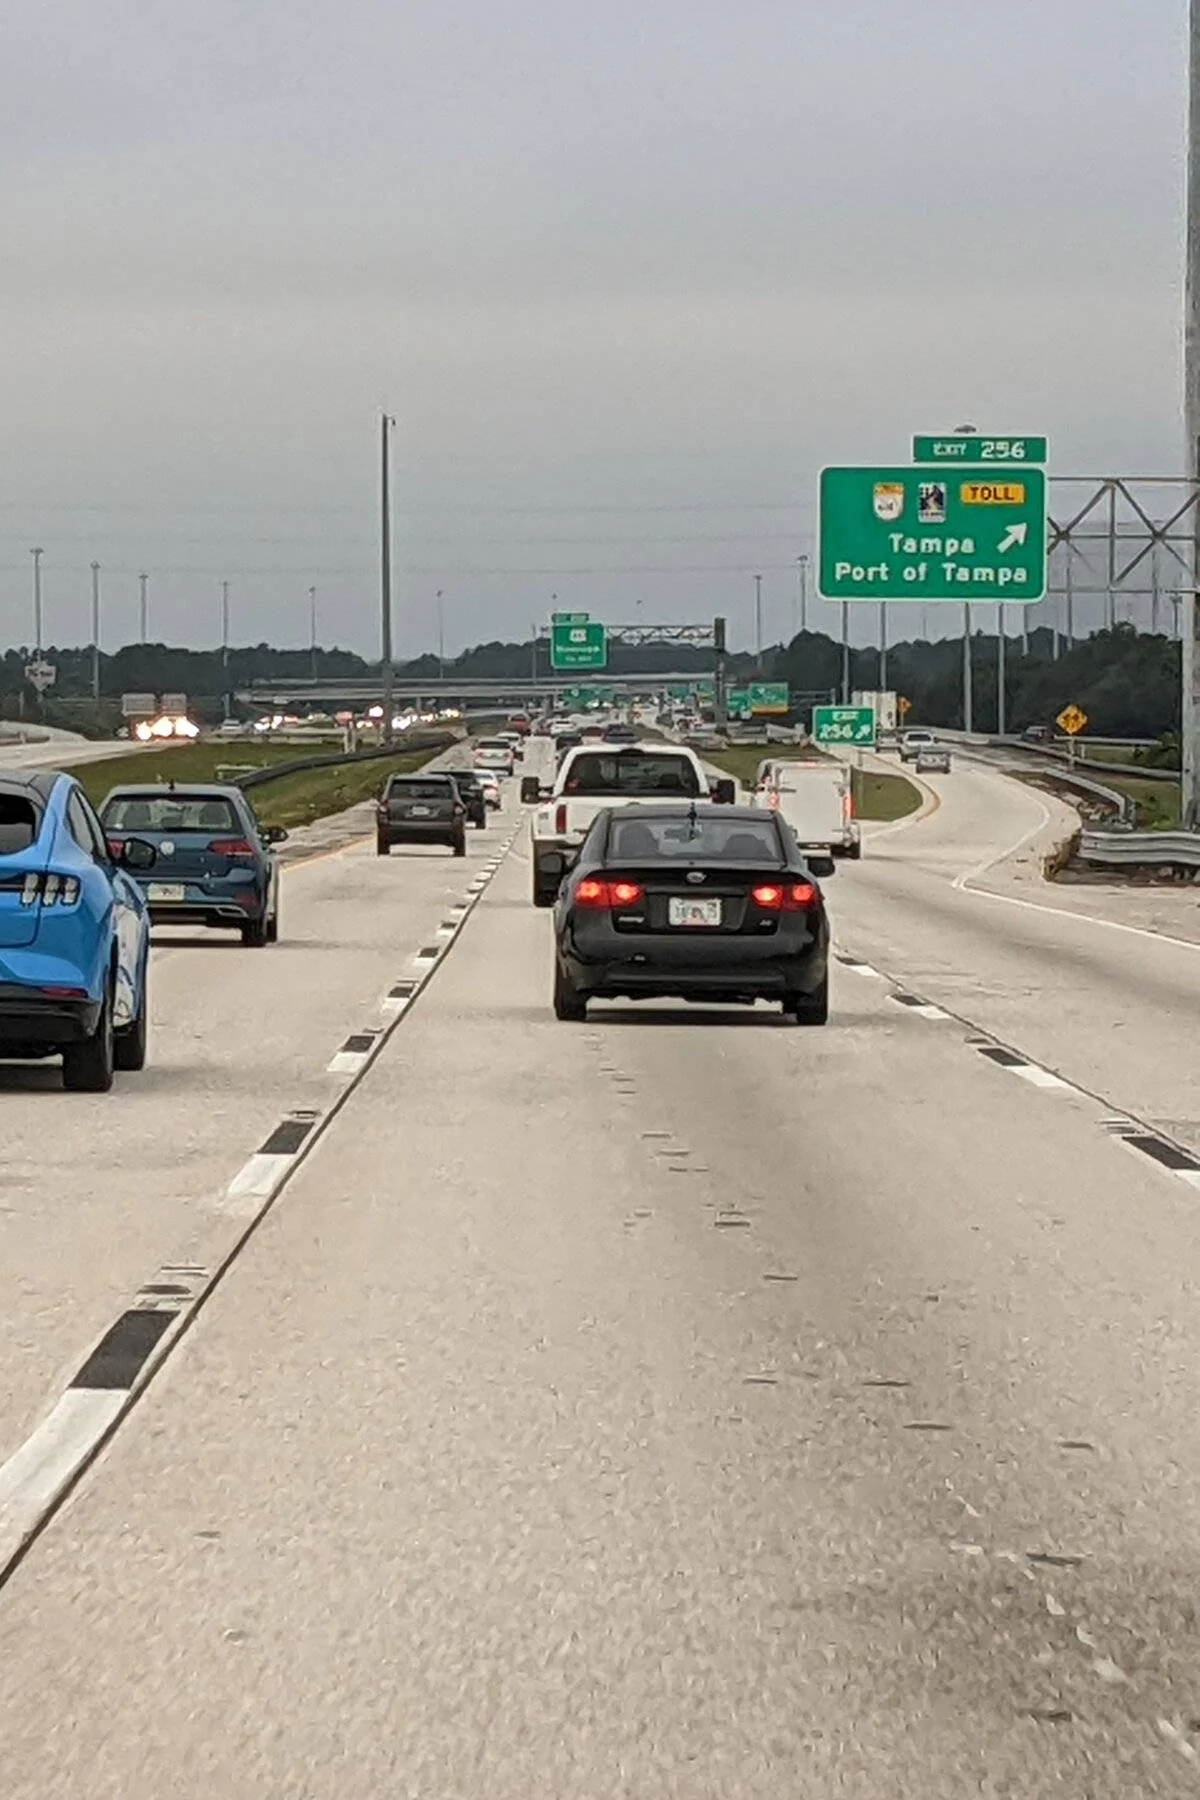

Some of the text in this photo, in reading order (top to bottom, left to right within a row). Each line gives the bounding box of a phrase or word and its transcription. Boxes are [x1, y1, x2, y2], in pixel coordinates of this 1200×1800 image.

[980, 440, 1025, 459] 256
[969, 486, 1015, 501] TOLL
[889, 532, 975, 557] Tampa
[834, 561, 1027, 587] Port of Tampa
